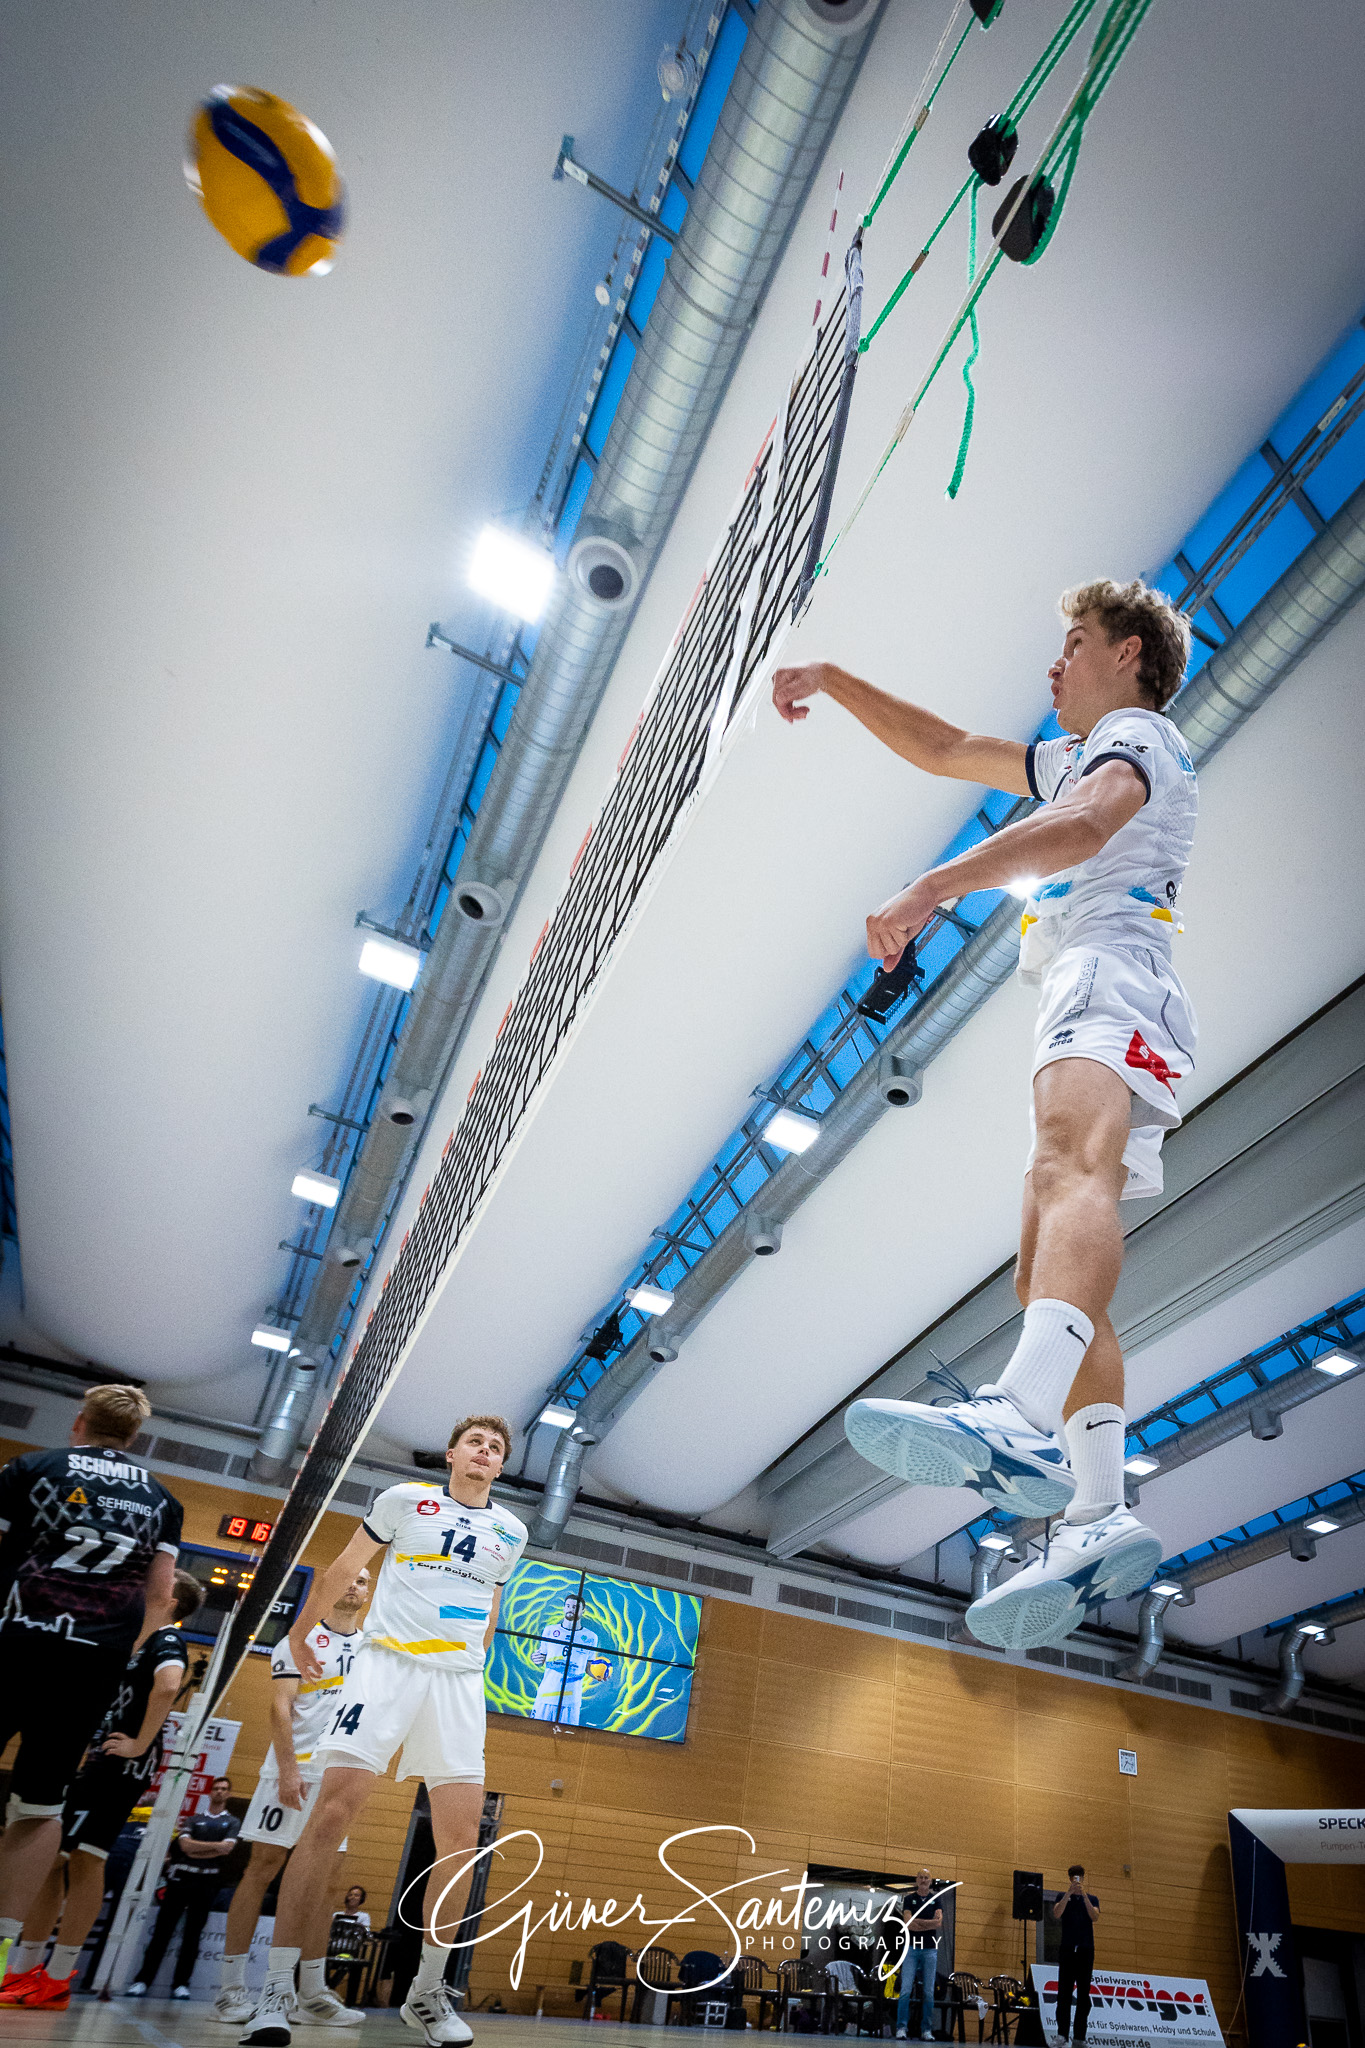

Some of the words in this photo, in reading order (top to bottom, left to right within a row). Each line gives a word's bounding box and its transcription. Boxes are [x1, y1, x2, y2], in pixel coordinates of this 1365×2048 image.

[68, 1454, 148, 1484] SCHMITT
[97, 1496, 152, 1517] SEHRING
[227, 1517, 249, 1537] 19
[251, 1522, 272, 1542] 16
[51, 1526, 138, 1574] 27
[441, 1529, 477, 1563] 14
[330, 1703, 364, 1736] 14
[67, 1810, 90, 1836] 7
[257, 1805, 283, 1832] 10
[1318, 1817, 1365, 1830] SPECK
[1097, 2020, 1108, 2029] für
[1152, 2024, 1176, 2036] Hobby
[1177, 2027, 1191, 2035] und
[1191, 2027, 1217, 2037] Schule
